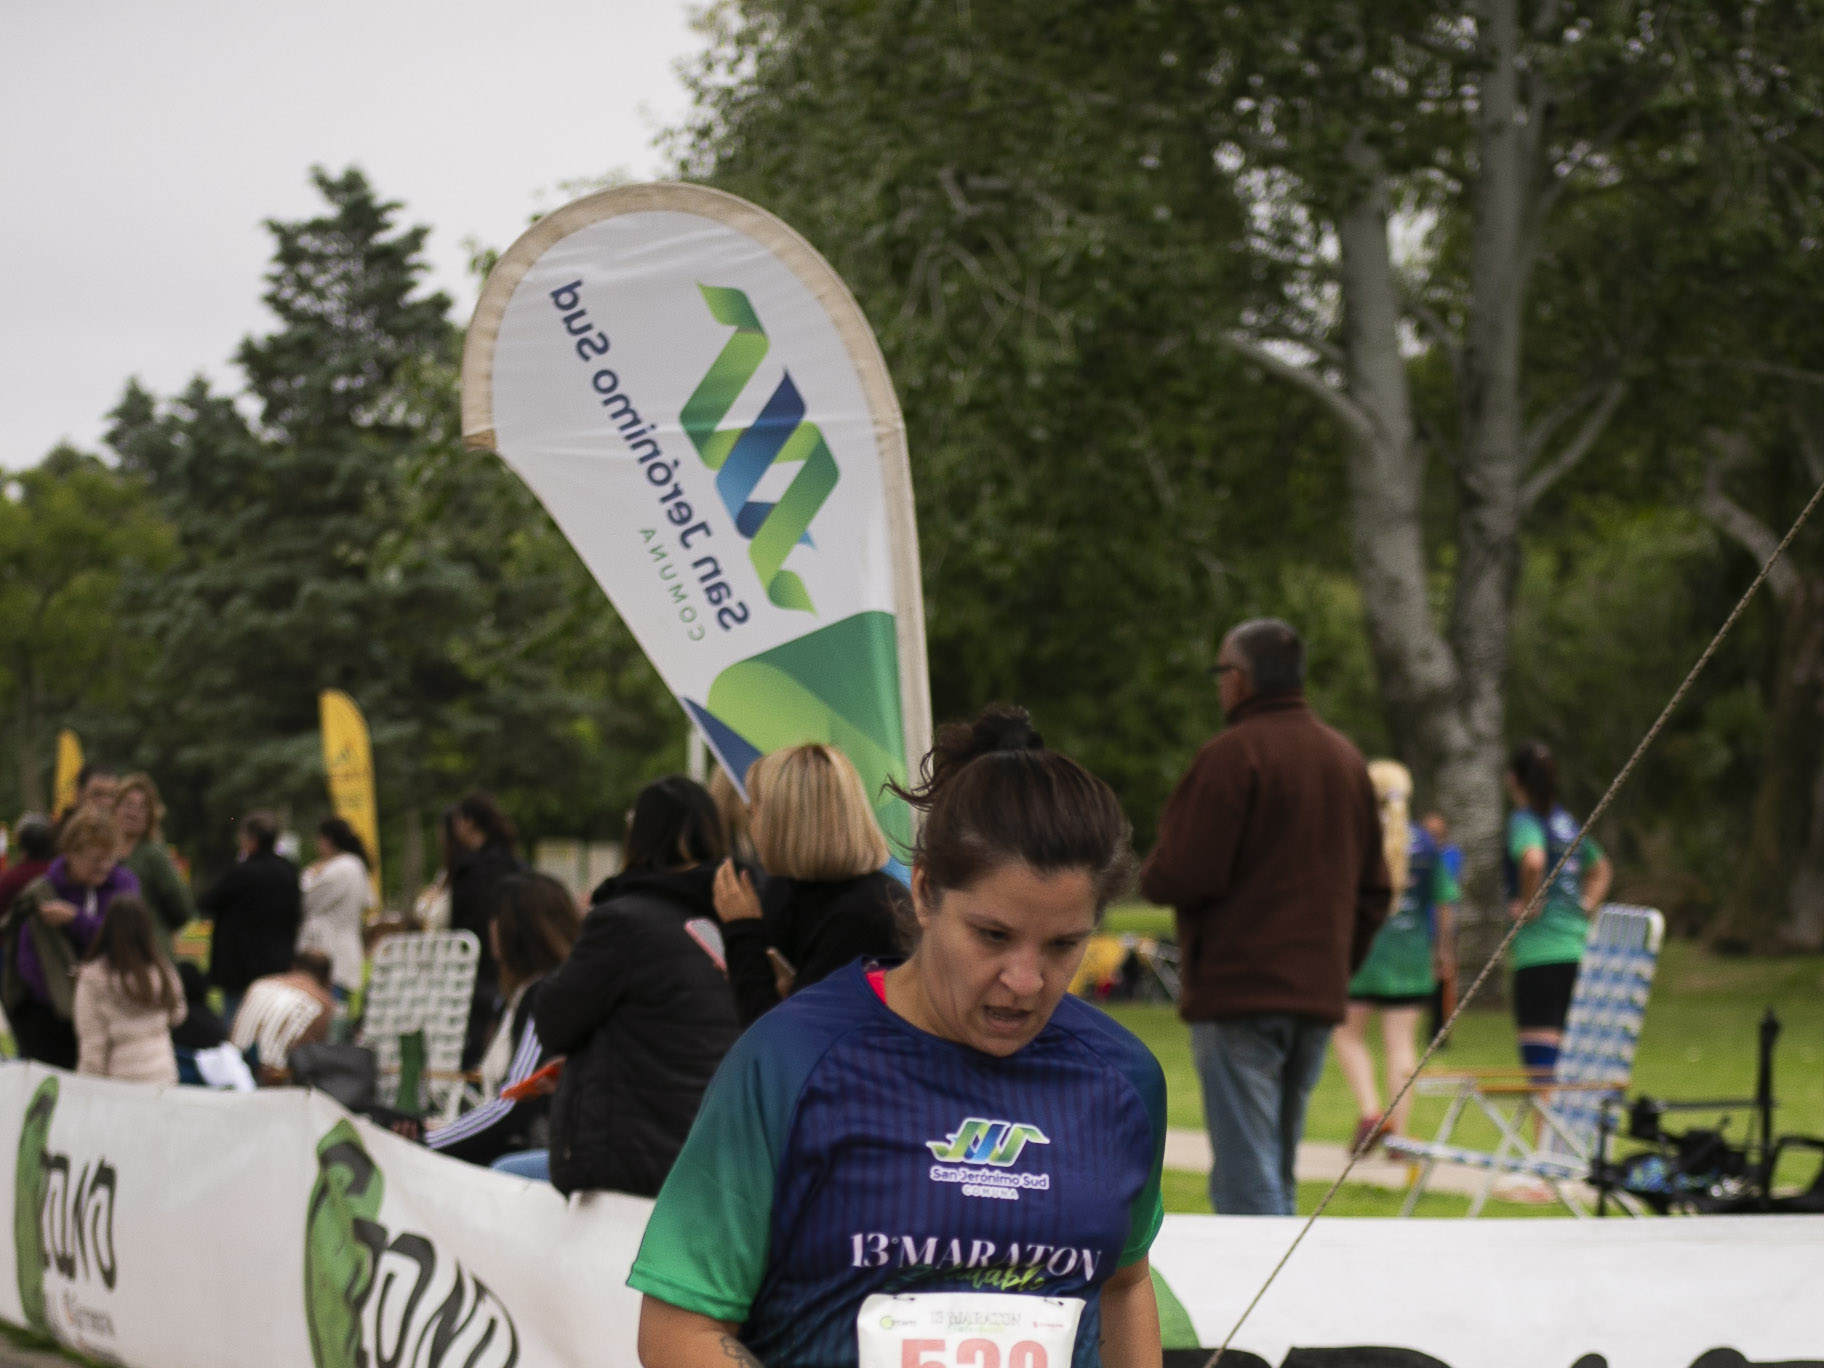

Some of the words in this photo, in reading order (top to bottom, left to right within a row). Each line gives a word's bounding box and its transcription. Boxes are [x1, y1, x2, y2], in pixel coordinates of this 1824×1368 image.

[931, 1167, 957, 1181] San
[959, 1169, 1021, 1186] Jerónimo
[1022, 1174, 1049, 1188] Sud
[962, 1186, 1019, 1199] COMUNA
